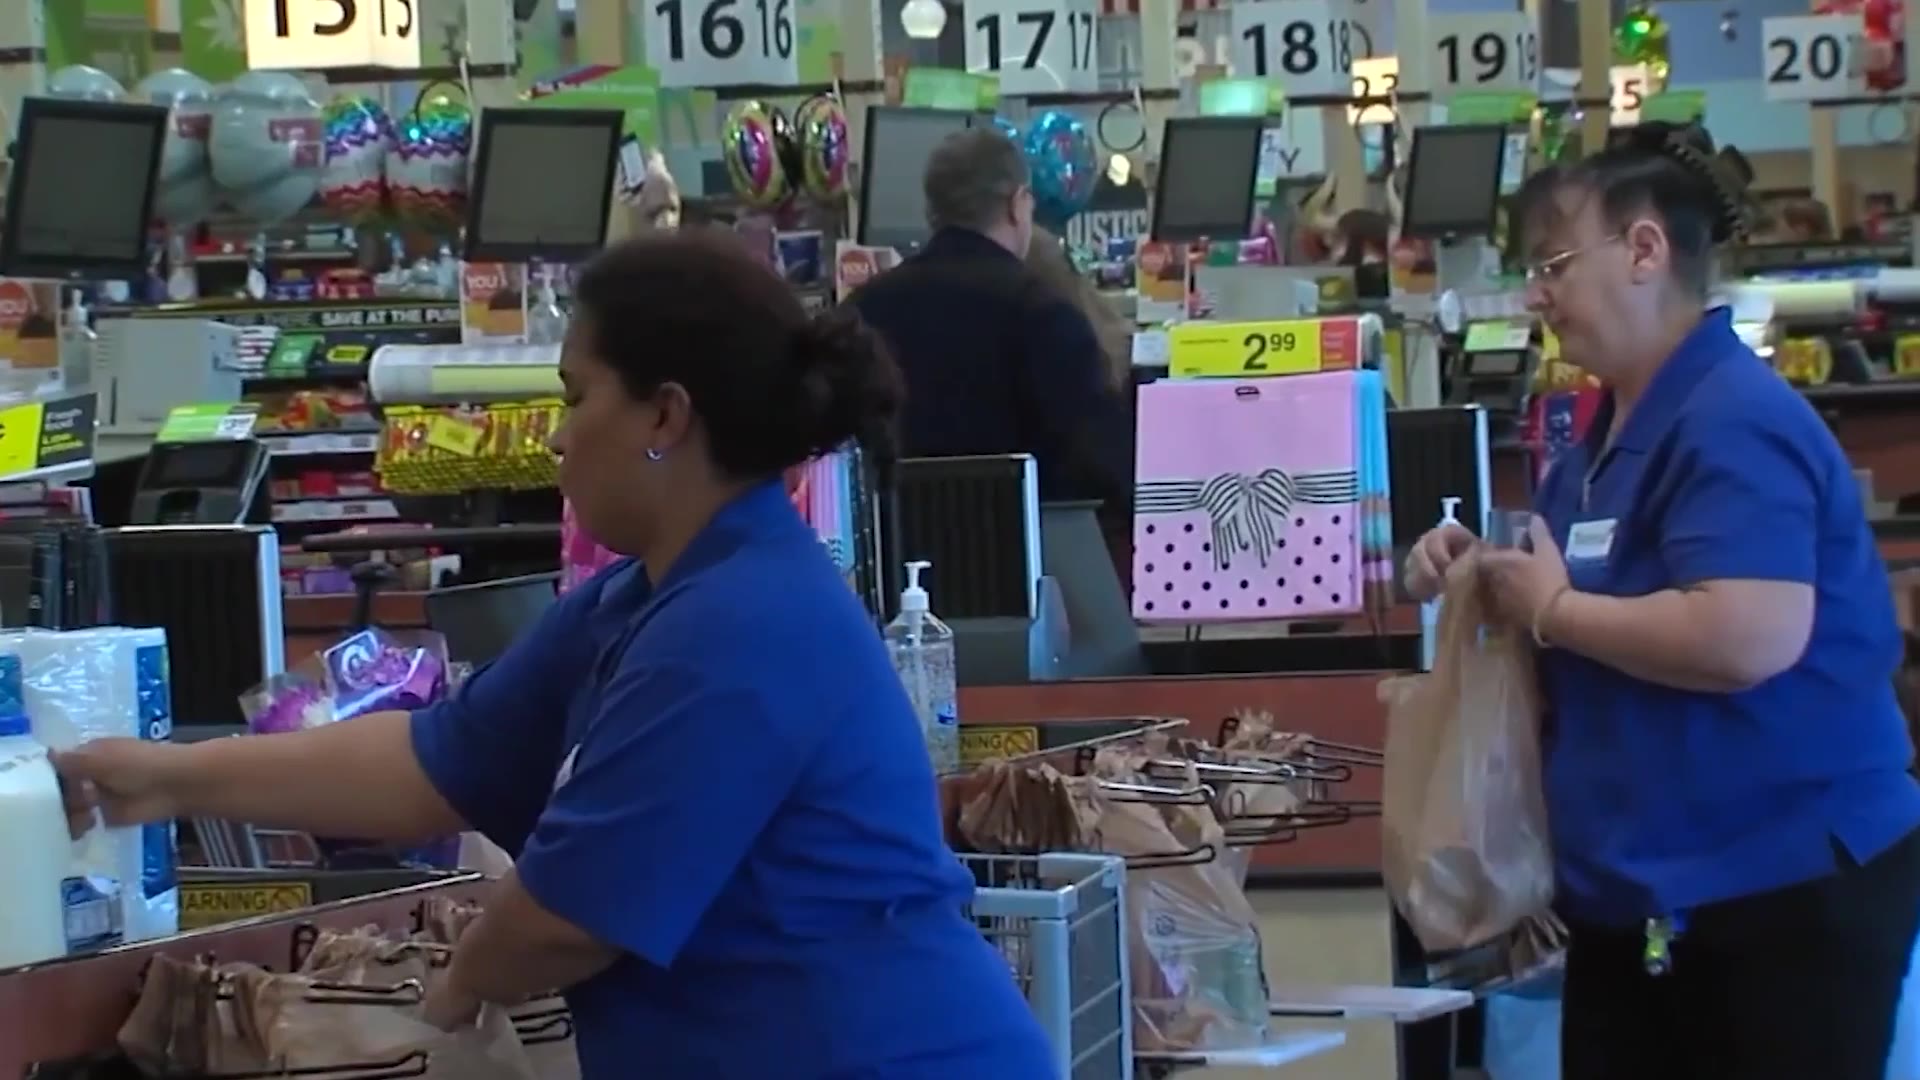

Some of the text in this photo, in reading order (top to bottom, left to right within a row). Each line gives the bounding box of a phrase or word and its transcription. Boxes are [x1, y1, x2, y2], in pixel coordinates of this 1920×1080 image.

[655, 0, 745, 61] 16
[756, 0, 792, 60] 16
[975, 10, 1055, 71] 17
[1068, 10, 1093, 71] 17
[1243, 20, 1318, 76] 18
[1328, 19, 1350, 74] 18
[1438, 32, 1507, 83] 19
[1768, 34, 1842, 83] 20
[467, 275, 498, 289] YOU
[321, 311, 364, 326] SAVE
[366, 310, 387, 325] AT
[391, 309, 422, 324] THE
[177, 891, 267, 911] ARNING
